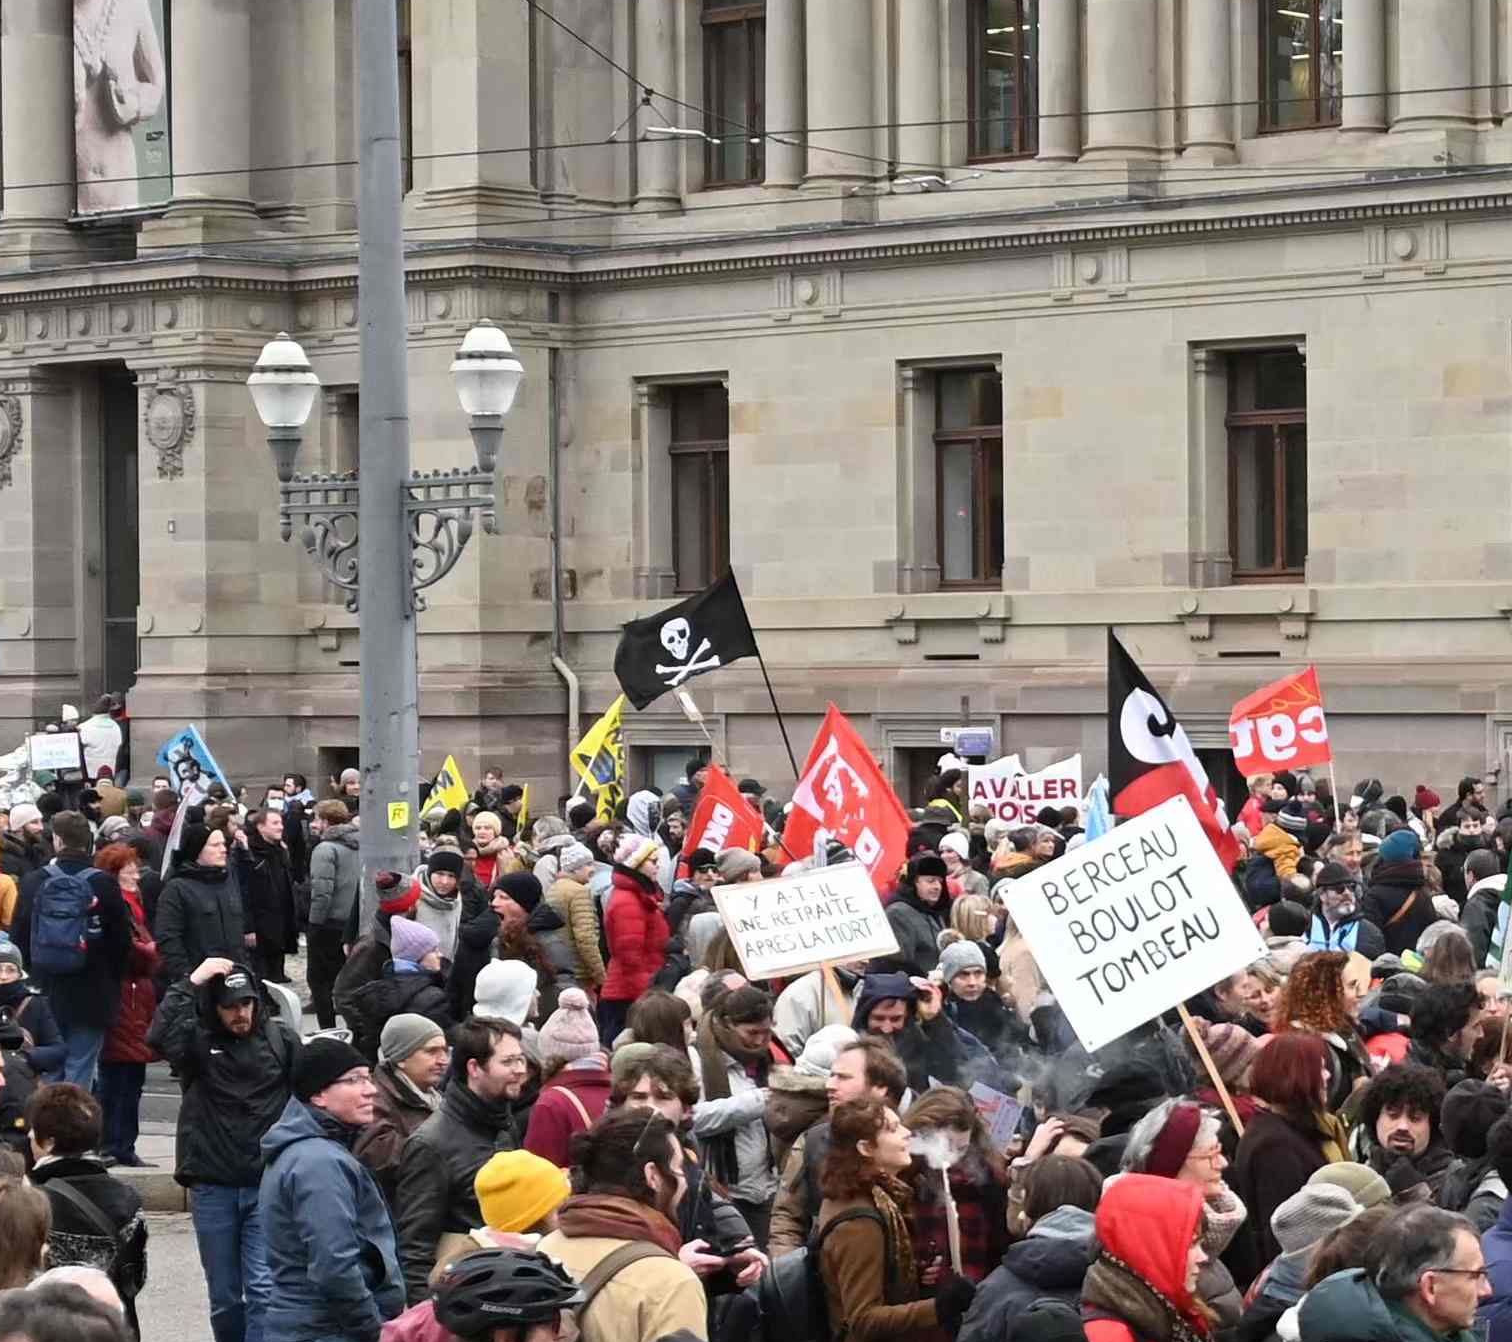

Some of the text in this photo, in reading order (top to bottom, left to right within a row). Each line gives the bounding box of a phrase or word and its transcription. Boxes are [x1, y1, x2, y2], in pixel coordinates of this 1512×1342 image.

[746, 882, 839, 911] Y A-T-IL
[1040, 823, 1178, 916] BERCEAU
[733, 896, 861, 934] UNE RETRAITE
[798, 928, 826, 951] LA
[825, 916, 875, 947] MORT
[1068, 864, 1193, 955] BOULOT
[1076, 907, 1221, 1006] TOMBEAU
